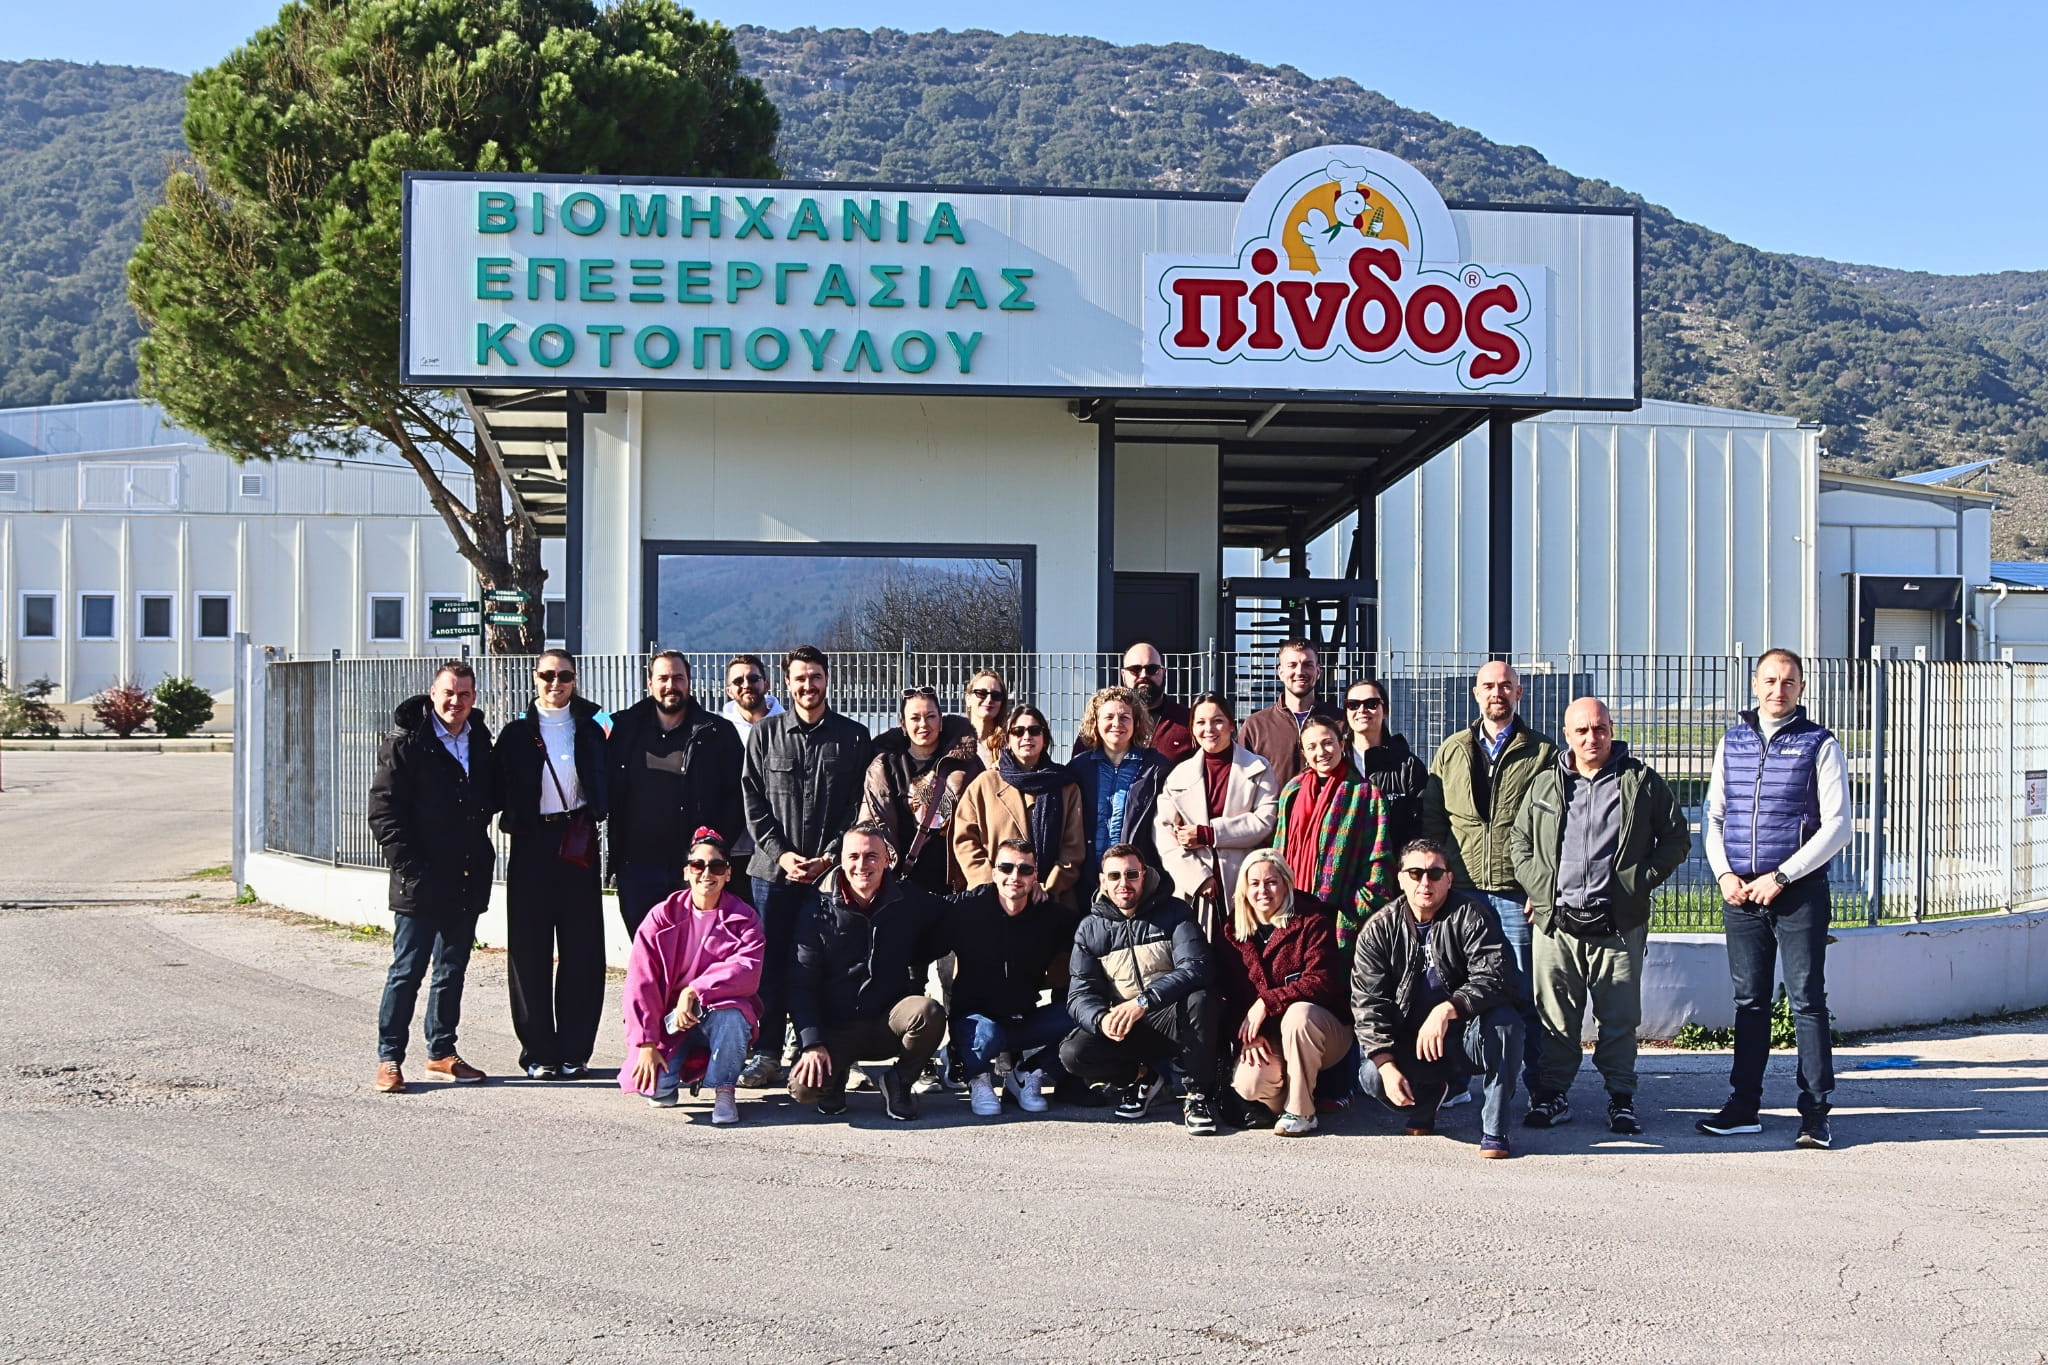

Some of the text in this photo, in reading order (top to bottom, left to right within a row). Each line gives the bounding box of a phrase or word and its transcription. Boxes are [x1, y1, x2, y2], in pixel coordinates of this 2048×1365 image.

[477, 191, 965, 245] ΒΙΟΜΗΧΑΝΙΑ
[476, 257, 1036, 311] ΕΠΕΞΕΡΓΑΣΙΑΣ
[476, 322, 983, 374] ΚΟΤΟΠΟΥΛΟΥ
